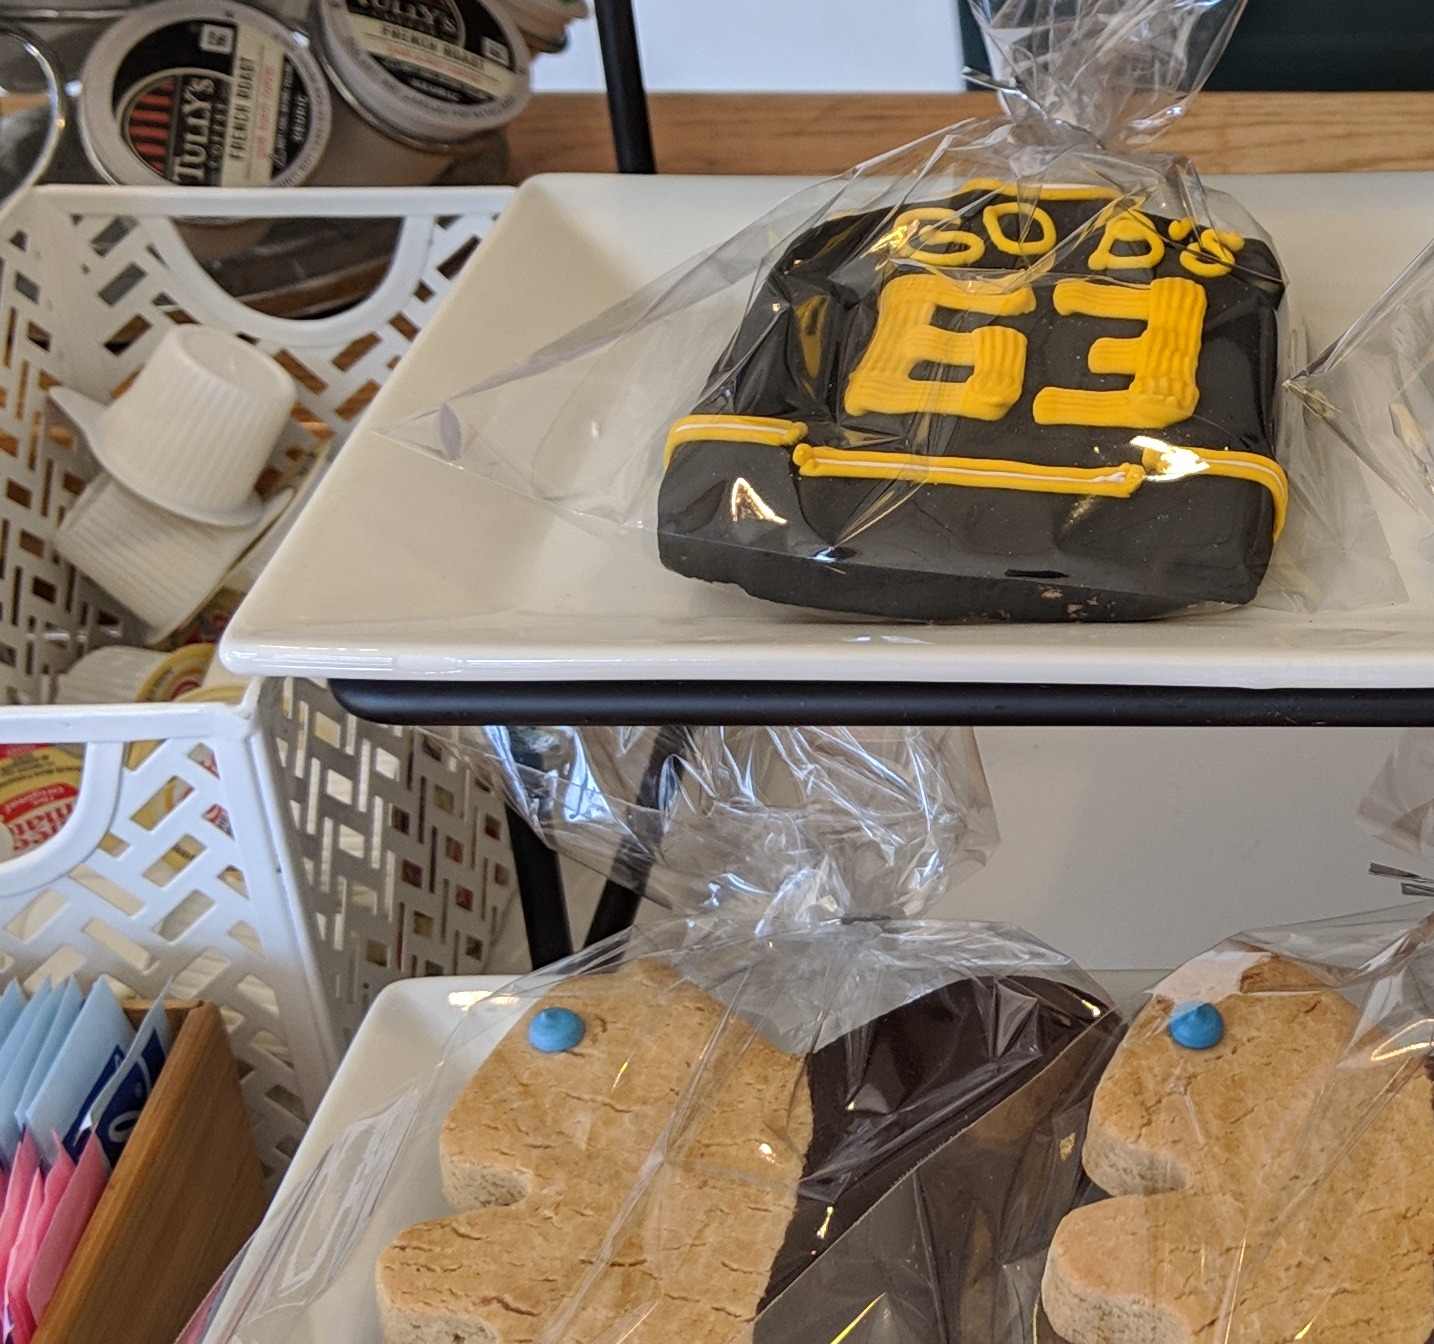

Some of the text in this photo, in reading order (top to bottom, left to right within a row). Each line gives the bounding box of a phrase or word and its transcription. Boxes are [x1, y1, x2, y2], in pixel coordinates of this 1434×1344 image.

[382, 20, 439, 52] FRENCH
[172, 78, 215, 184] TULLY'S
[228, 56, 256, 160] FRENCH ROAST
[844, 272, 1208, 429] 63
